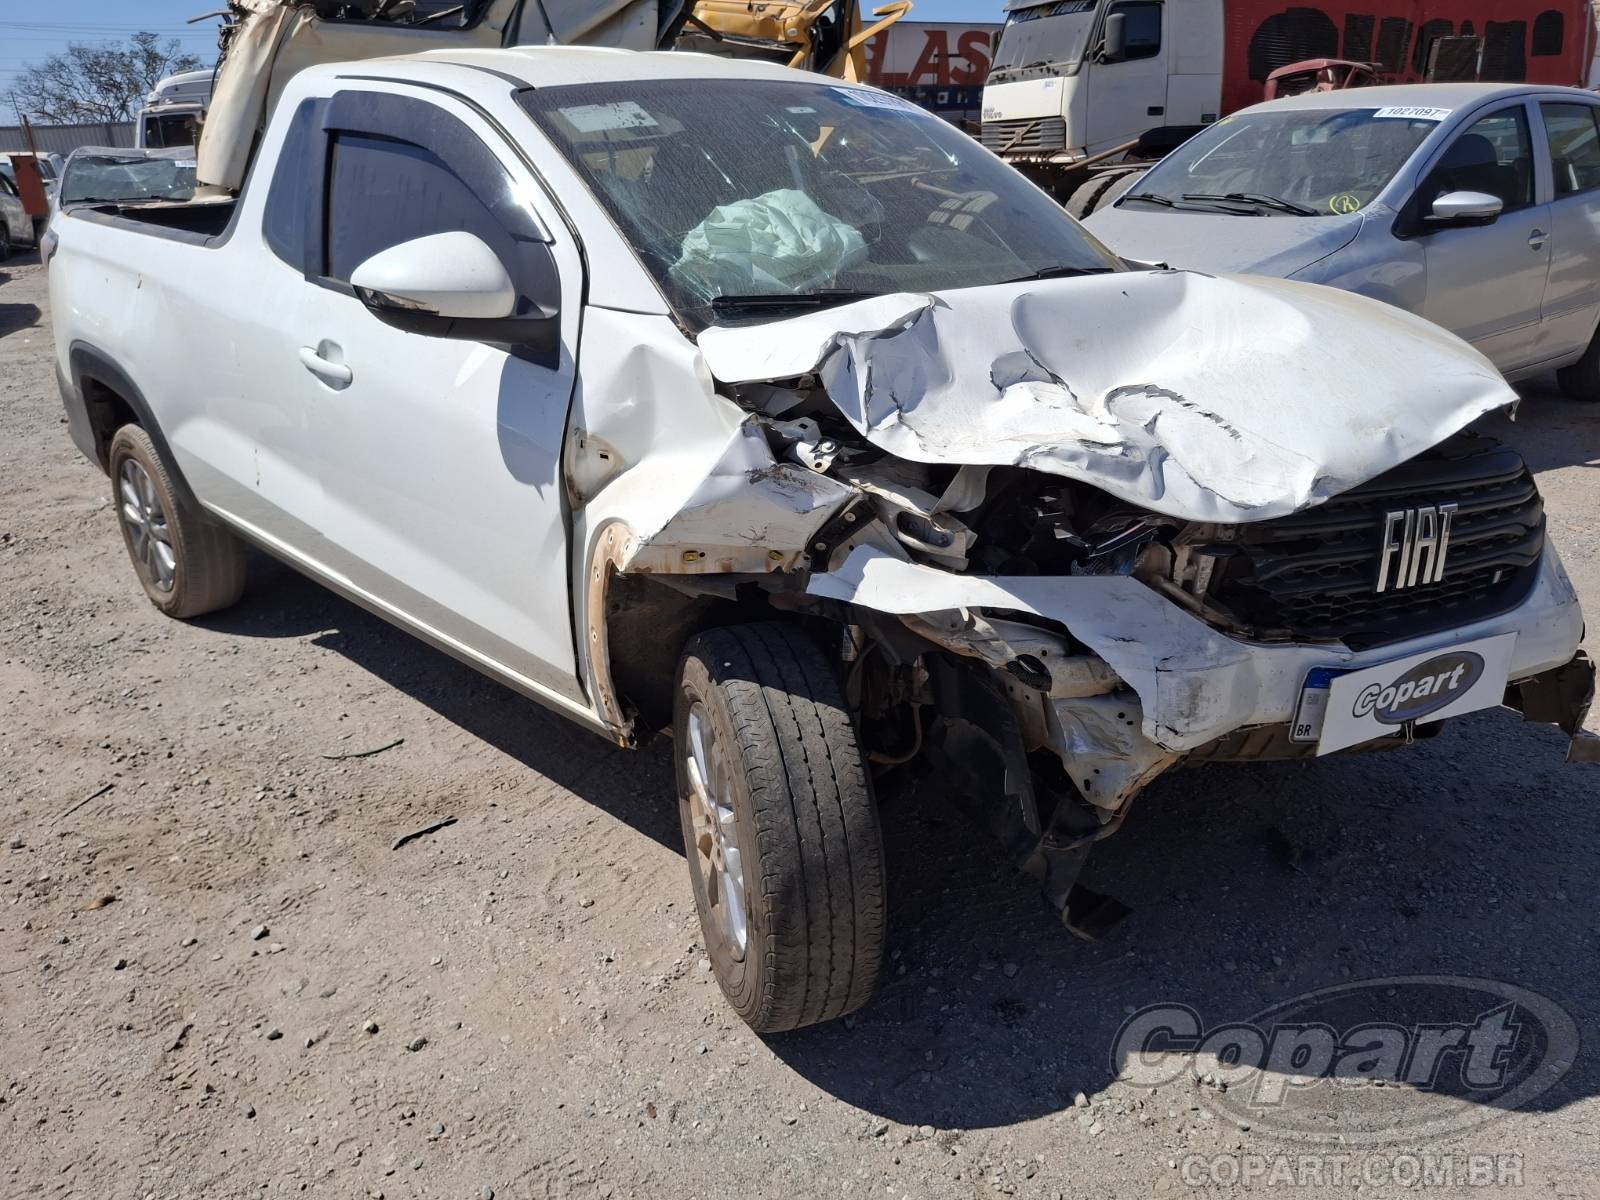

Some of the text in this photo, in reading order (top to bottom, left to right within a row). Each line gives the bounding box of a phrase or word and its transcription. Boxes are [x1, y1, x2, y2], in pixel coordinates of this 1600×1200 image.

[1387, 107, 1440, 117] 1027097
[1376, 504, 1458, 592] FIAT
[1352, 662, 1464, 718] Copart
[1296, 724, 1311, 736] BR
